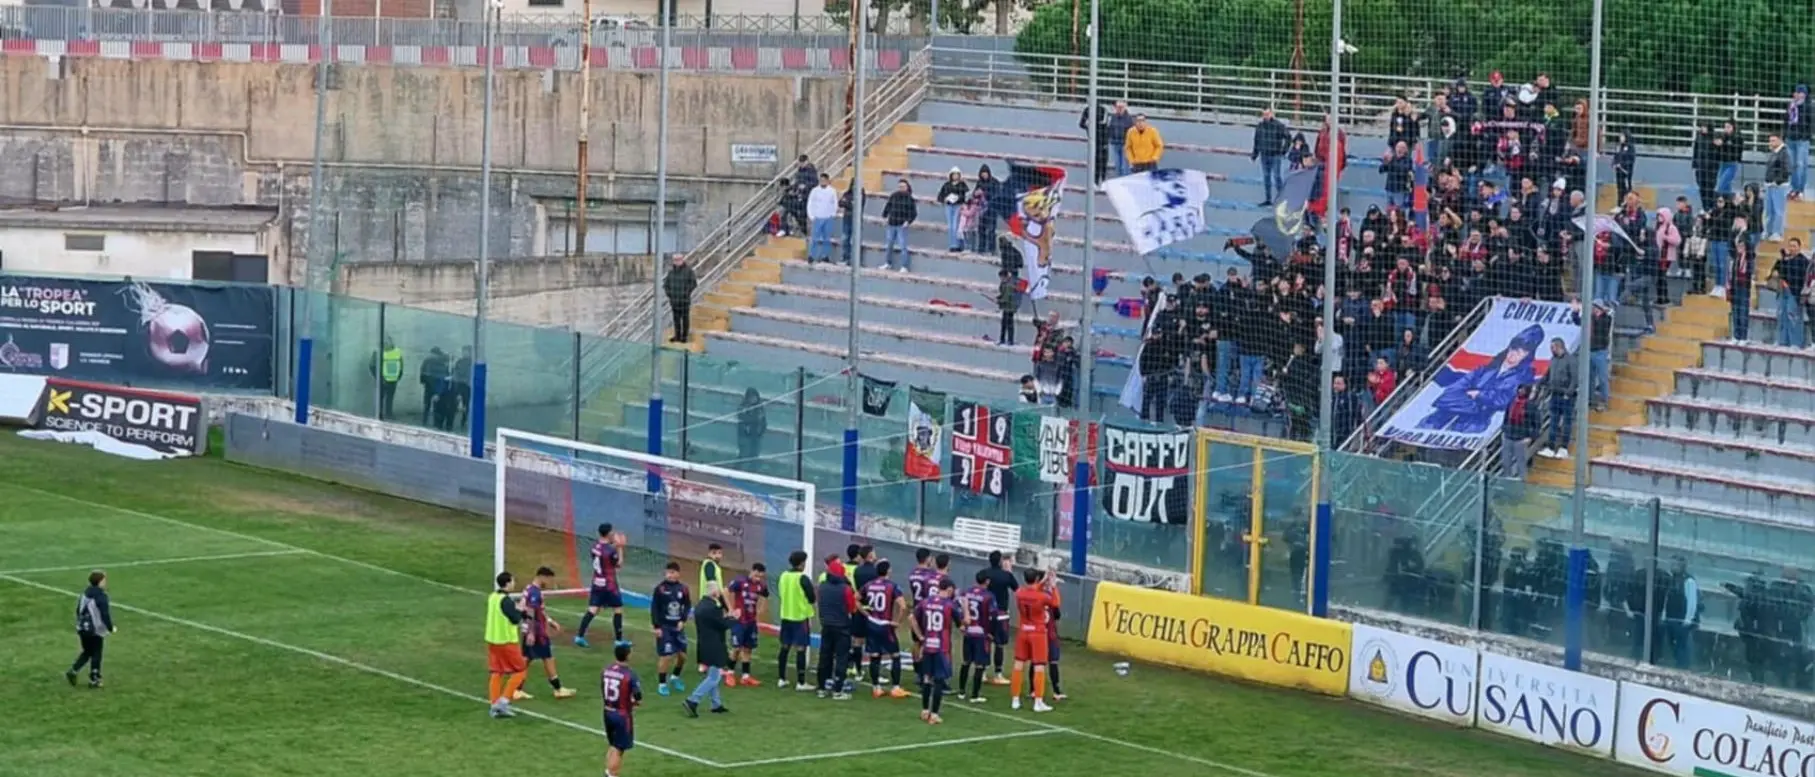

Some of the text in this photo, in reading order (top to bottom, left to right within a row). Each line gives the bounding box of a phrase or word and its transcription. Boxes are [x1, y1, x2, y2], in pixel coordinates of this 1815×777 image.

[1, 286, 19, 297] LA
[1, 297, 96, 315] PER LO SPORT
[1503, 302, 1557, 323] CURVA
[47, 388, 197, 431] K-SPORT
[45, 416, 194, 447] SCIENCE TO PERFORM
[1106, 427, 1189, 469] CAFFO
[1113, 473, 1174, 523] OUT
[867, 591, 886, 612] 20
[912, 581, 923, 600] 2
[926, 610, 943, 631] 19
[1103, 601, 1187, 645] VECCHIA
[1190, 618, 1268, 661] GRAPPA
[1271, 632, 1345, 673] CAFFO
[604, 677, 621, 702] 13
